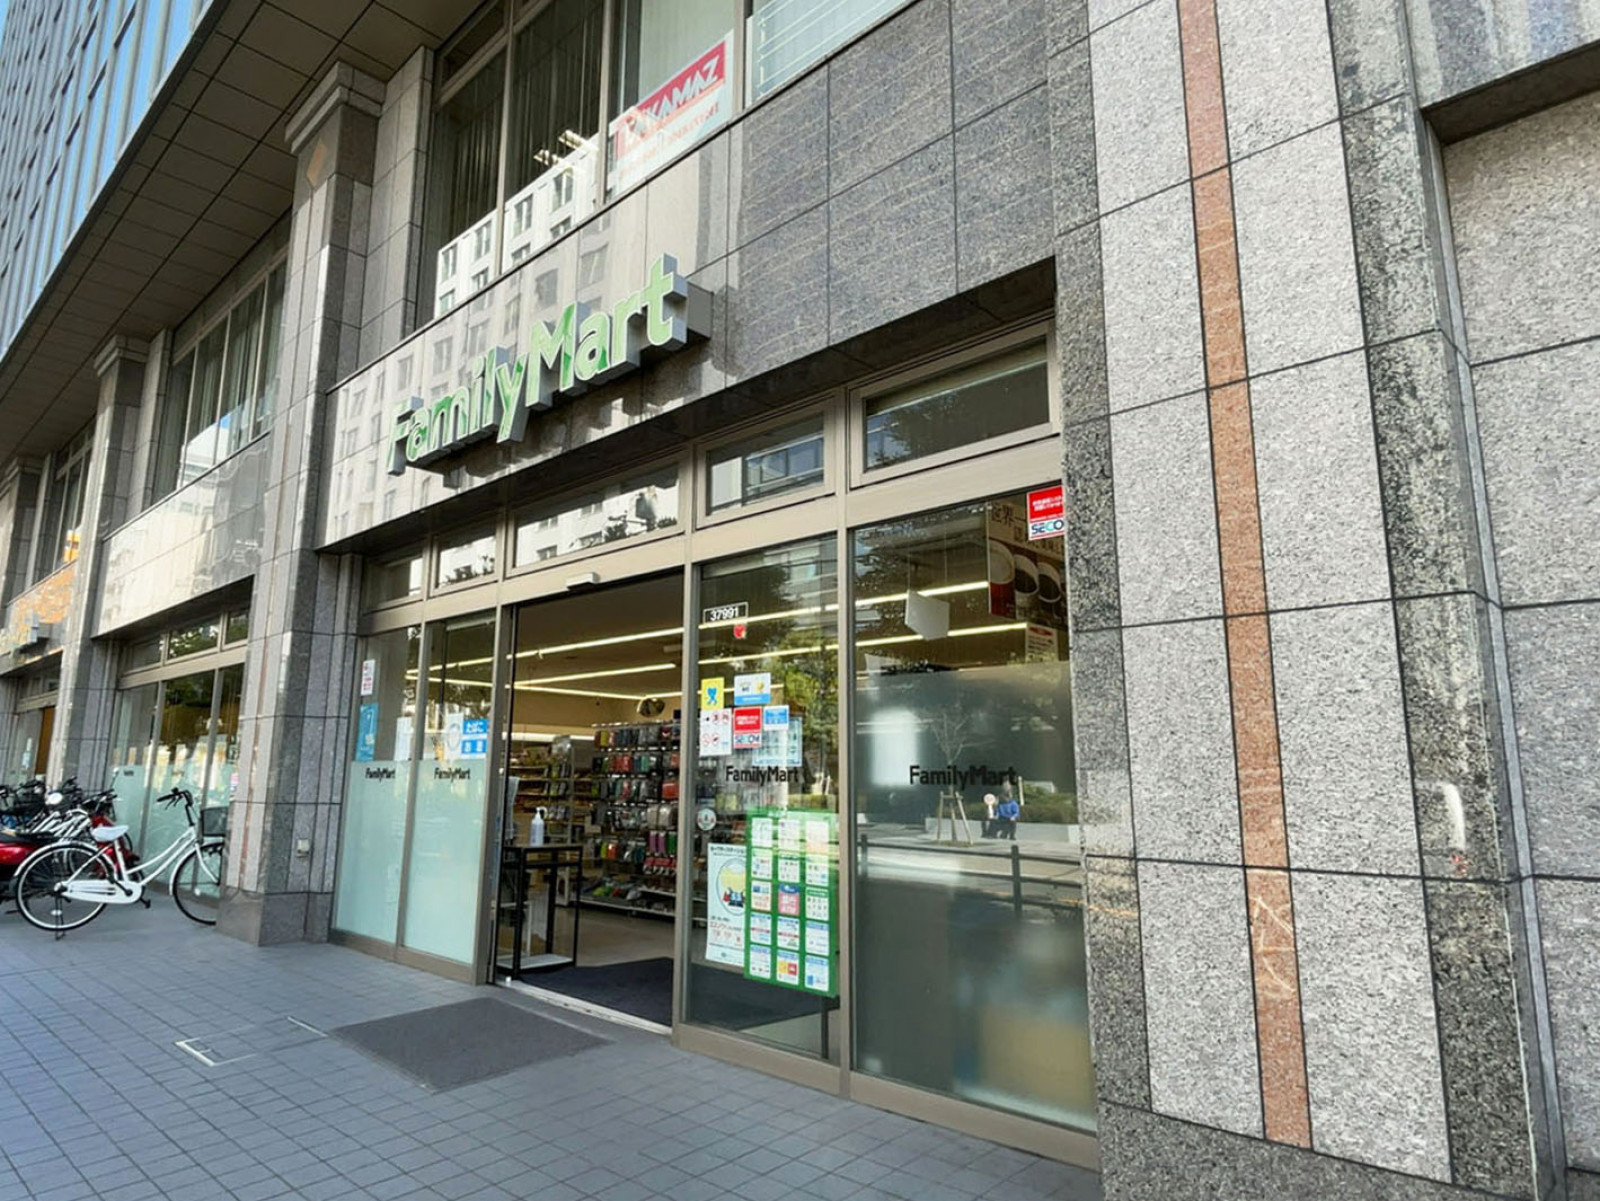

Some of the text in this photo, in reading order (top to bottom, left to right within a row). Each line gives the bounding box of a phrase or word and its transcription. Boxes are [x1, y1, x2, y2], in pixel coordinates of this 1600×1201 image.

[386, 253, 686, 475] FamilyMart
[709, 607, 739, 622] 37991
[365, 766, 396, 782] FamilyMart
[434, 766, 471, 783] FamilyMart
[725, 765, 799, 786] FamilyMart
[908, 764, 1018, 790] FamilyMart
